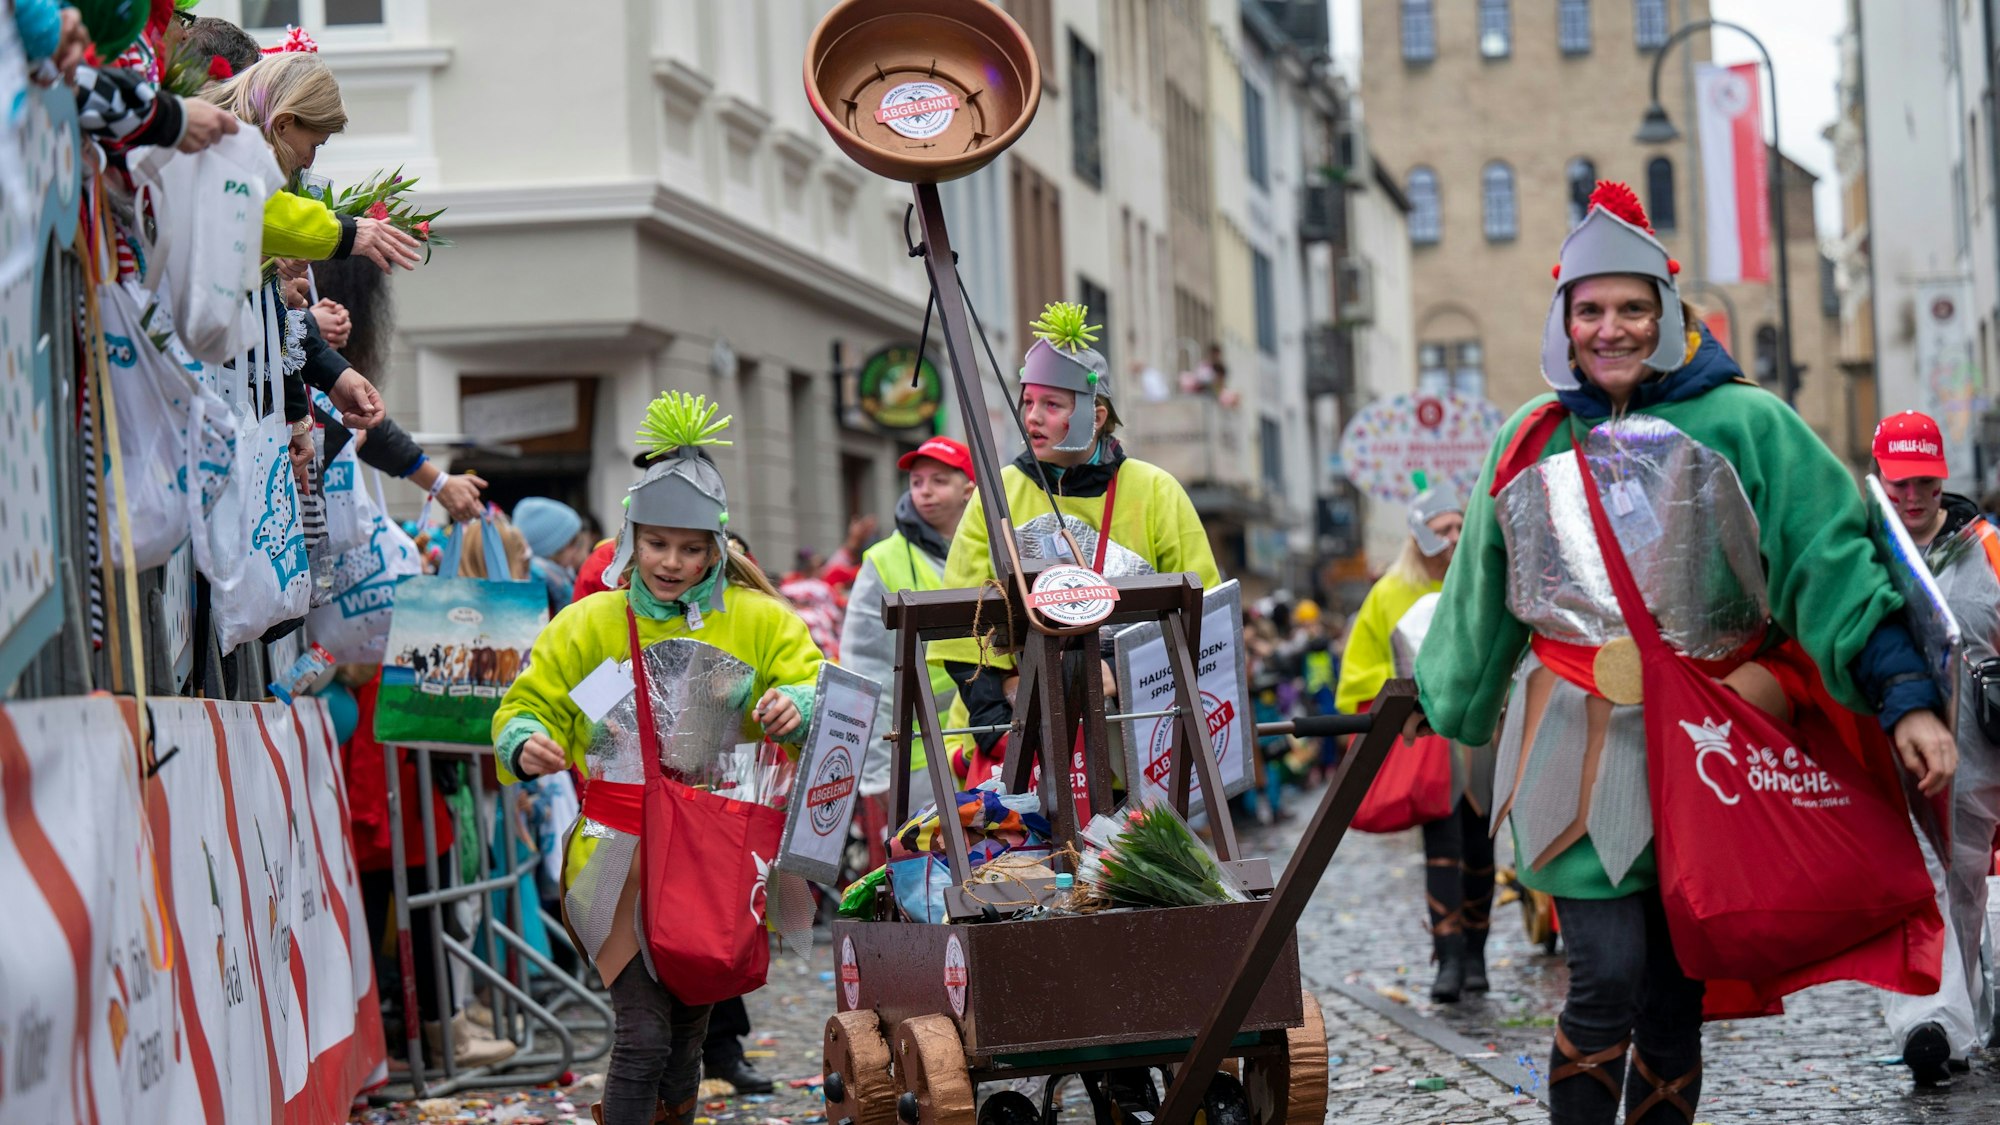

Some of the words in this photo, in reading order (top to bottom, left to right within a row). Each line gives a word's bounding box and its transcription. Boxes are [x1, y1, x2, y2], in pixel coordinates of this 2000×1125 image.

[882, 97, 953, 120] ABGELEHNT
[1068, 569, 1101, 583] Jugendamt
[344, 585, 394, 614] WDR
[1034, 588, 1113, 605] ABGELEHNT
[1047, 608, 1075, 620] Sozialamt
[846, 731, 860, 745] 100%
[811, 780, 853, 803] ABGELEHNT
